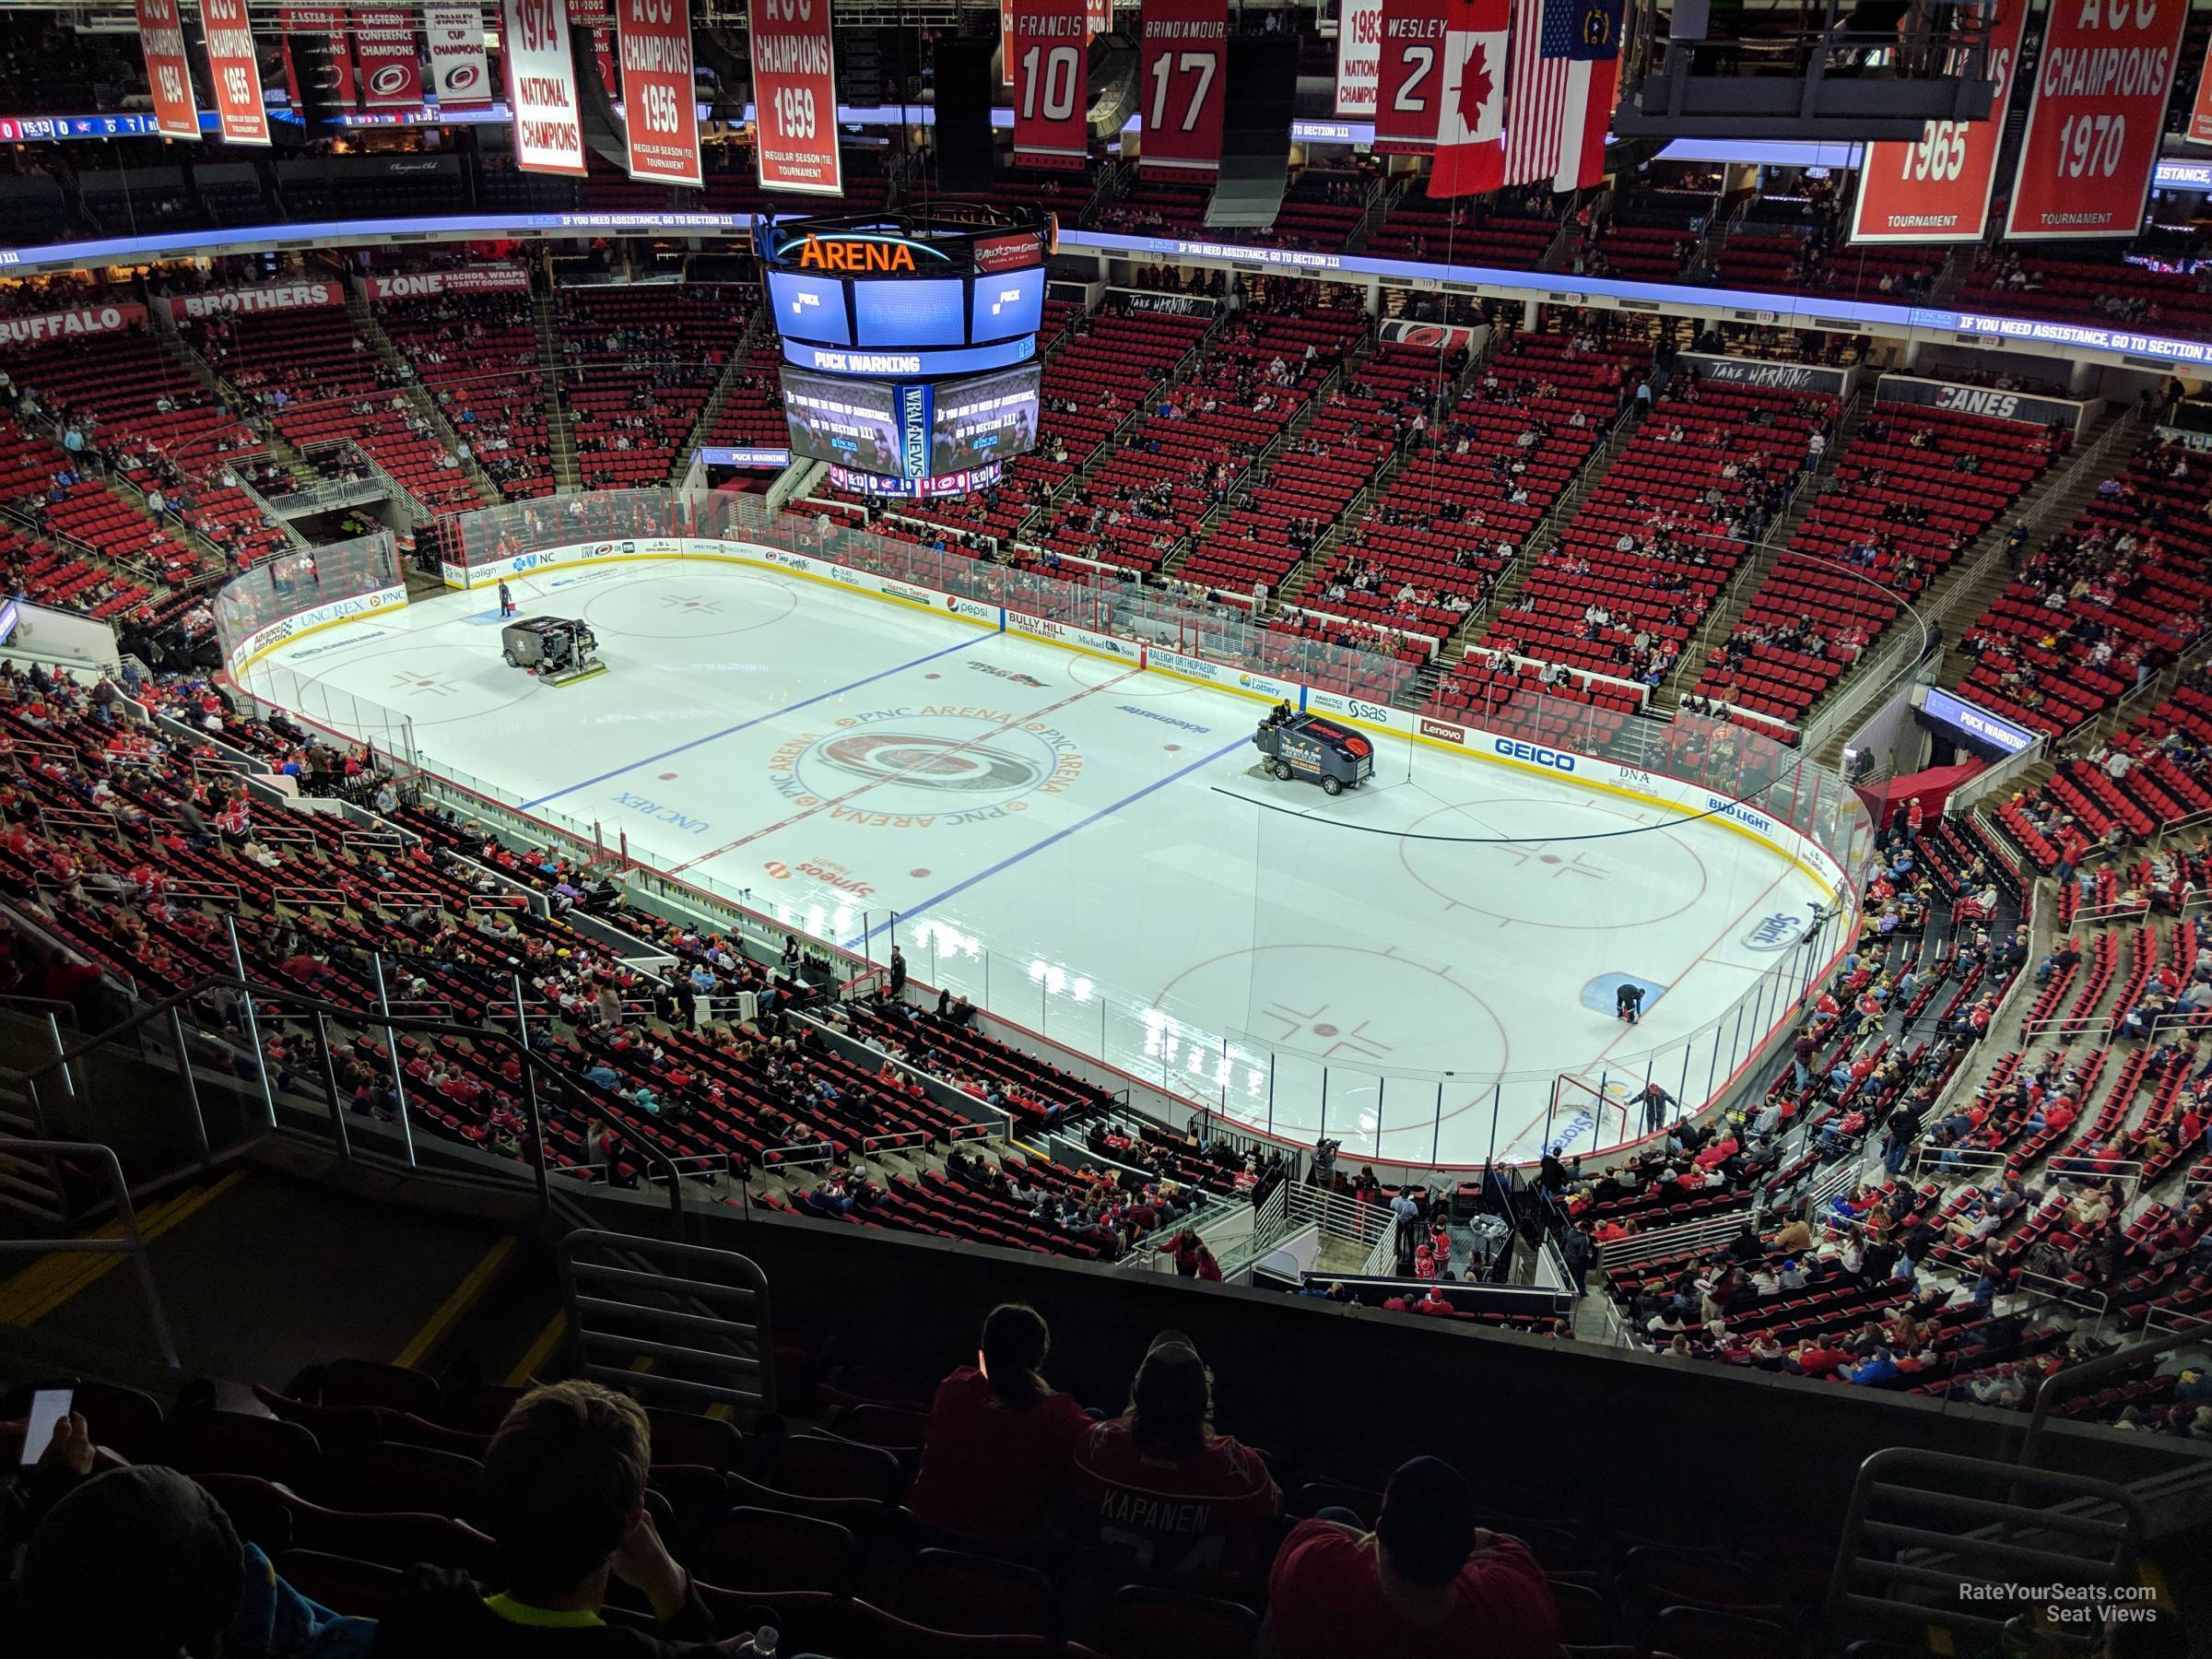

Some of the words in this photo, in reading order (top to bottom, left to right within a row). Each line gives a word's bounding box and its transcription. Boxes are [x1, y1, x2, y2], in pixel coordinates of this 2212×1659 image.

[145, 0, 170, 19] ACC
[209, 0, 237, 19] ACC
[362, 14, 404, 24] EASTERN
[633, 0, 672, 24] ACC
[766, 0, 811, 21] ACC
[2077, 0, 2157, 29] ACC
[358, 30, 412, 41] CONFERENCE
[448, 30, 465, 40] CUP
[516, 0, 558, 52] 1974
[1018, 16, 1082, 37] FRANCIS
[1146, 21, 1224, 39] BRIND'AMOUR
[1388, 18, 1447, 39] WESLEY
[143, 29, 182, 55] CHAMPIONS
[209, 29, 252, 58] CHAMPIONS
[361, 45, 414, 56] CHAMPIONS
[433, 44, 484, 55] CHAMPIONS
[625, 34, 688, 75] CHAMPIONS
[757, 34, 829, 76] CHAMPIONS
[1394, 46, 1434, 112] 2
[2044, 47, 2168, 97] CHAMPIONS
[159, 65, 183, 103] 1954
[224, 67, 251, 104] 1955
[520, 77, 569, 107] NATIONAL
[1024, 46, 1078, 120] 10
[1151, 53, 1217, 132] 17
[642, 84, 678, 134] 1956
[774, 87, 816, 139] 1959
[22, 121, 50, 134] 15:13
[60, 122, 69, 135] 0
[522, 120, 578, 152] CHAMPIONS
[1303, 125, 1335, 136] SECTION
[1336, 127, 1348, 137] 111
[633, 143, 660, 155] REGULAR
[660, 146, 683, 157] SEASON
[1902, 121, 1970, 181] 1965
[2057, 114, 2125, 178] 1970
[645, 159, 685, 171] TOURNAMENT
[765, 150, 794, 162] REGULAR
[795, 152, 820, 164] SEASON
[778, 165, 822, 178] TOURNAMENT
[563, 217, 571, 225] IF
[572, 217, 588, 225] YOU
[590, 217, 610, 225] NEED
[611, 216, 663, 226] ASSISTANCE,
[664, 217, 674, 225] GO
[675, 217, 686, 225] TO
[687, 217, 720, 225] SECTION
[721, 217, 733, 225] 111
[1887, 214, 1958, 228] TOURNAMENT
[2041, 212, 2112, 225] TOURNAMENT
[800, 233, 915, 271] ARENA
[1179, 243, 1187, 252] IF
[1188, 244, 1202, 254] YOU
[1203, 245, 1221, 256] NEED
[1222, 247, 1268, 262] ASSISTANCE,
[1270, 252, 1280, 262] GO
[1281, 253, 1291, 263] TO
[1292, 253, 1326, 266] SECTION
[1327, 256, 1339, 267] 111
[377, 276, 443, 297] ZONE
[446, 273, 488, 281] NACHOS,
[185, 285, 328, 317] BROTHERS
[1129, 295, 1150, 309] TAKE
[1154, 295, 1195, 316] WARNING
[0, 308, 121, 344] BUFFALO
[1960, 316, 1973, 328] IF
[1975, 317, 1999, 332] YOU
[2000, 320, 2031, 335] NEED
[2033, 324, 2110, 347] ASSISTANCE,
[2111, 335, 2128, 347] GO
[2130, 336, 2147, 350] TO
[2148, 339, 2203, 359] SECTION
[815, 352, 847, 371] PUCK
[849, 354, 920, 372] WARNING
[1712, 361, 1745, 378] TAKE
[1748, 363, 1815, 389] WARNING
[906, 389, 924, 429] WRAL
[1936, 387, 2018, 417] CANES
[830, 423, 859, 438] SECTION
[860, 425, 876, 440] 111
[732, 453, 752, 462] PUCK
[753, 453, 786, 462] WARNING
[910, 431, 924, 477] NEWS
[848, 474, 864, 486] 15:13
[870, 477, 877, 488] 0
[958, 474, 965, 487] 0
[971, 471, 986, 484] 15:13
[540, 553, 556, 564] NC
[582, 550, 594, 559] LIVE
[840, 568, 853, 578] DUKE
[841, 576, 859, 586] ENERGY
[382, 589, 406, 604] PNC
[887, 582, 907, 593] Harris
[909, 588, 929, 599] Teeter
[300, 609, 330, 627] UNC
[334, 599, 364, 618] REX
[960, 602, 988, 618] pepsi
[254, 625, 281, 644] Advance
[1009, 613, 1040, 629] BULLY
[1042, 622, 1065, 636] HILL
[1018, 625, 1056, 640] VINEYARDS
[253, 641, 265, 654] Auto
[265, 635, 282, 649] Parts
[1078, 635, 1105, 649] Michael
[1121, 647, 1135, 657] Son
[1148, 649, 1175, 664] RALEIGH
[1175, 654, 1217, 676] ORTHOPAEDIC
[1155, 661, 1174, 670] OFFICIAL
[1189, 670, 1210, 679] DOCTORS
[1252, 682, 1281, 696] Lottery
[1315, 695, 1343, 705] ANALYTICS
[854, 707, 912, 722] PNC
[919, 706, 1012, 724] ARENA
[1115, 705, 1211, 734] ticketmaster
[1359, 707, 1387, 723] sas
[1041, 730, 1077, 752] PNC
[1423, 723, 1462, 739] Lenovo
[1960, 711, 1983, 732] PUCK
[1984, 722, 2028, 750] WARNING
[768, 732, 824, 771] ARENA
[1495, 738, 1575, 772] GEICO
[1038, 754, 1083, 794] ARENA
[1619, 767, 1650, 783] DNA
[770, 774, 806, 798] PNC
[610, 792, 654, 815] REX
[657, 810, 710, 834] UNC
[830, 807, 935, 828] ARENA
[945, 804, 1009, 825] PNC
[1709, 798, 1735, 816] BUD
[1736, 810, 1771, 833] LIGHT
[794, 863, 876, 898] Syneos
[1754, 912, 1800, 944] Spirit
[1101, 1488, 1209, 1532] KAPANEN
